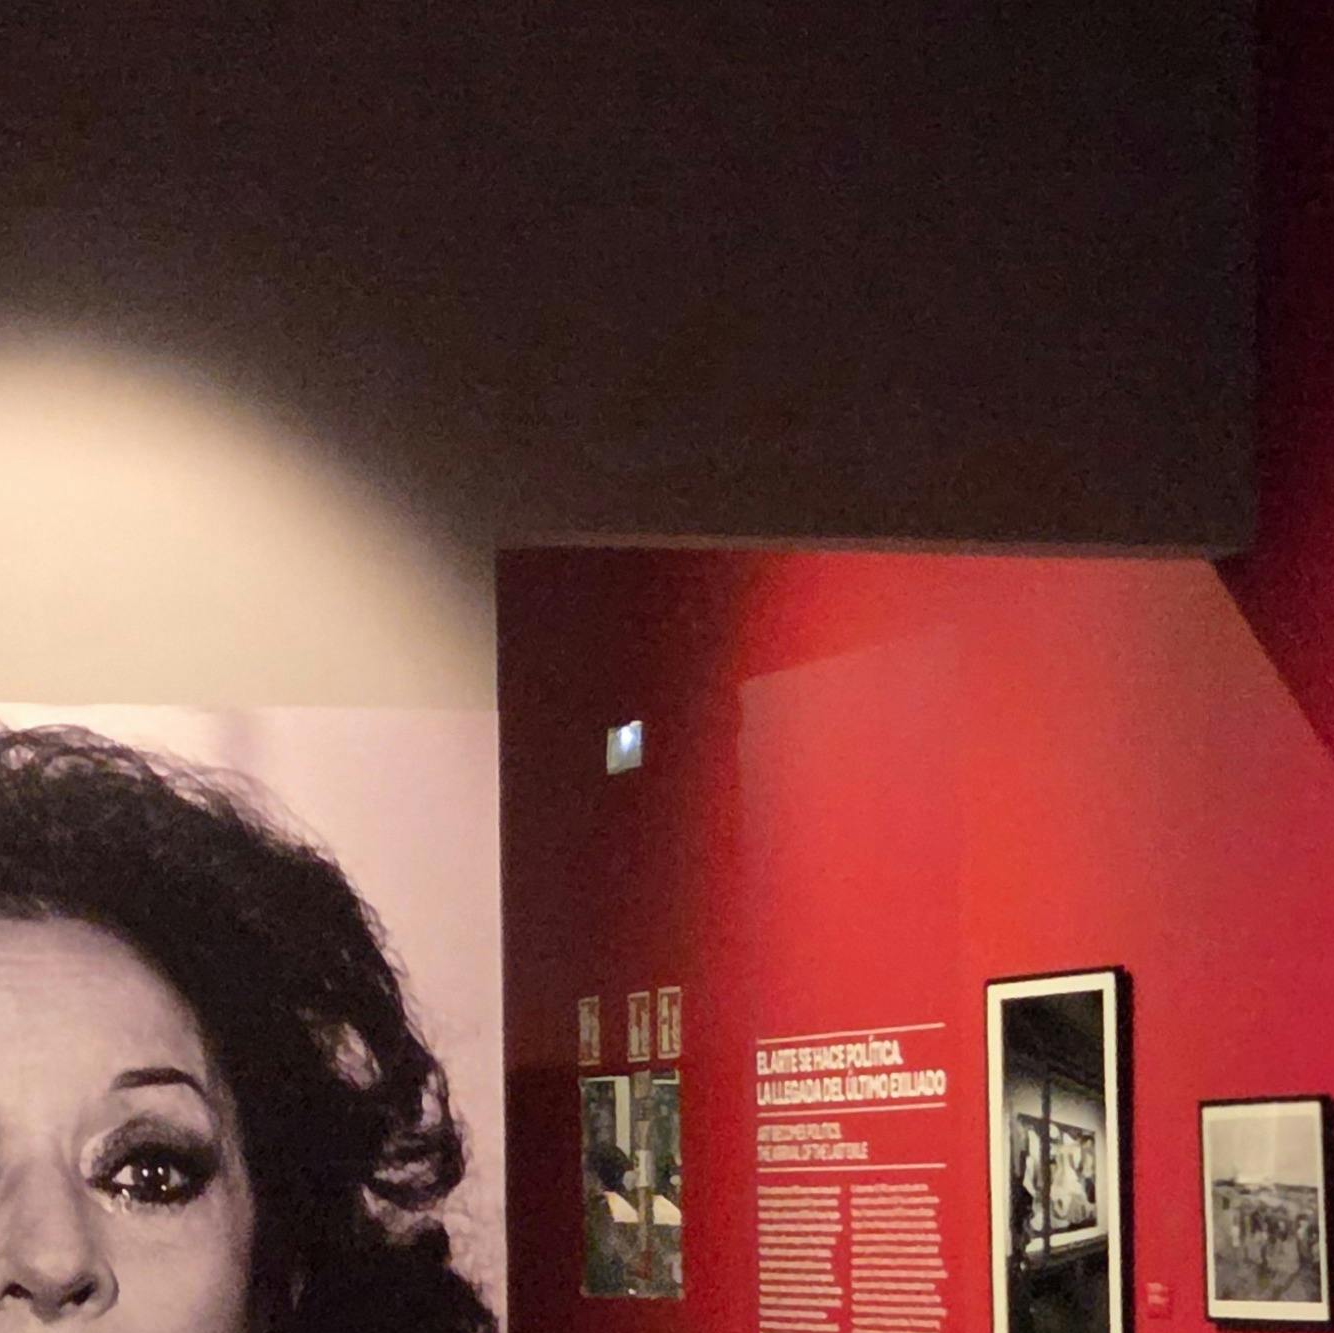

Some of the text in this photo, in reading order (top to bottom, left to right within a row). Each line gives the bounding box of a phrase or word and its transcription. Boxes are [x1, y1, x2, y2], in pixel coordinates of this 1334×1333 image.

[756, 1050, 772, 1075] EL
[771, 1048, 798, 1074] ARTE
[798, 1047, 813, 1072] SE
[813, 1044, 845, 1070] HACE
[756, 1069, 947, 1106] LA LLEGADA DEL ÚLTIMO EXILIADO
